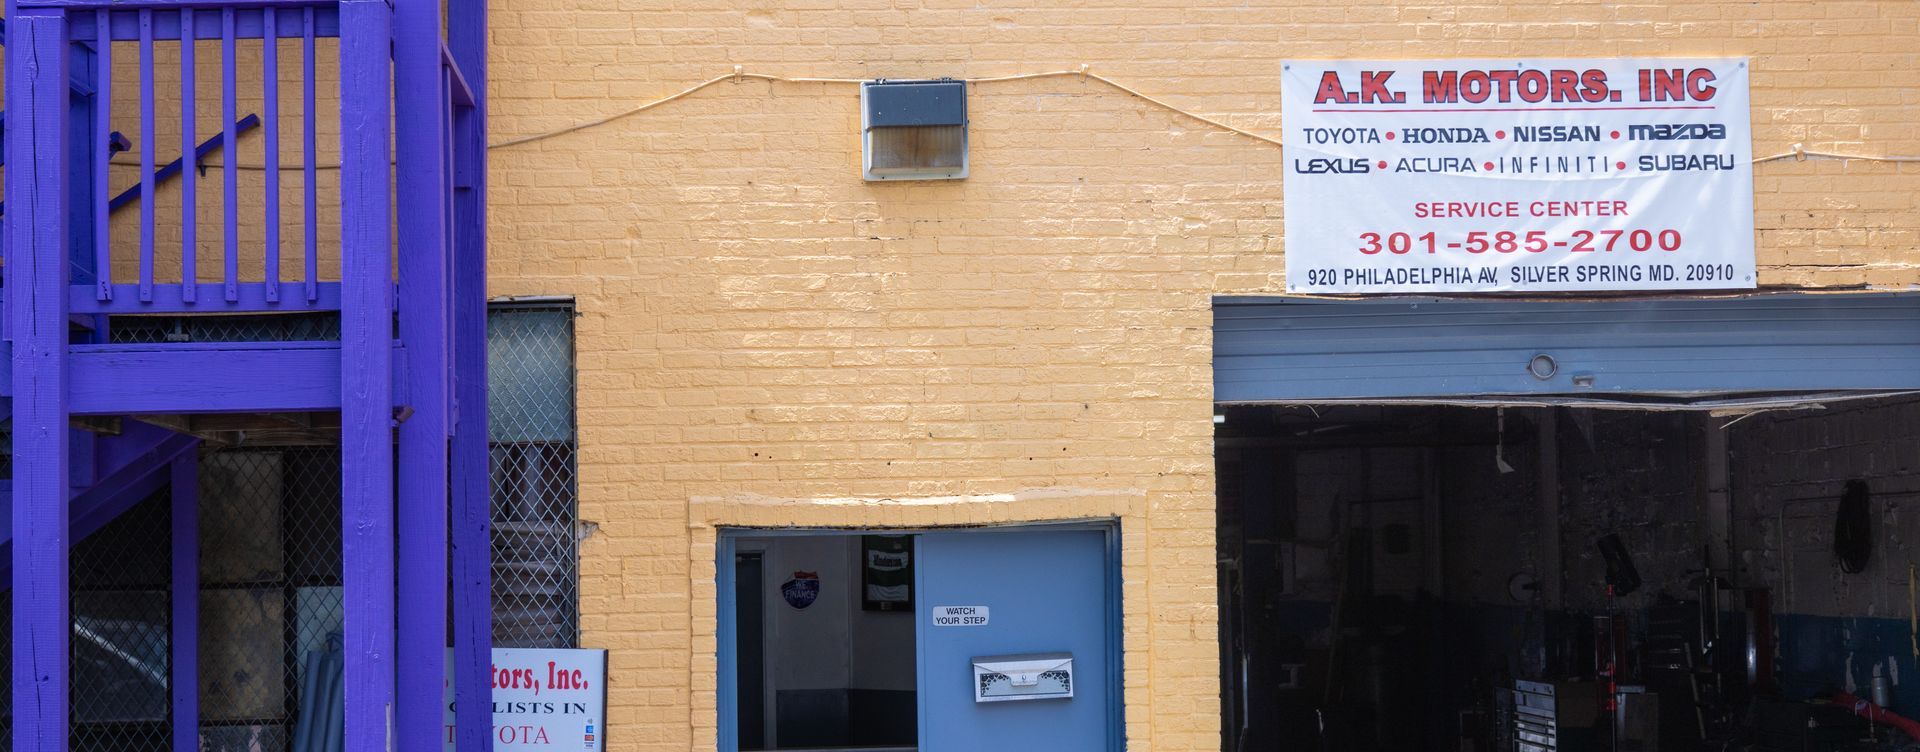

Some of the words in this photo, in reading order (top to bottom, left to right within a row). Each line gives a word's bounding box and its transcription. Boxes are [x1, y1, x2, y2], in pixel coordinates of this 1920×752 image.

[1313, 70, 1407, 104] A.K.
[1422, 68, 1623, 104] MOTORS.
[1638, 67, 1717, 102] INC
[1302, 127, 1381, 144] TOYOTA
[1401, 127, 1491, 144] HONDA
[1513, 125, 1601, 142] NISSAN
[1295, 158, 1370, 174] LEXUS
[1395, 157, 1477, 173] ACURA
[1499, 155, 1609, 174] INFINITI
[1638, 154, 1735, 171] SUBARU
[1414, 201, 1520, 218] SERVICE
[1529, 200, 1629, 217] CENTER
[1358, 229, 1682, 255] 301-585-2700
[1308, 268, 1337, 286] 920
[1344, 266, 1473, 285] PHILADELPHIA
[1477, 266, 1498, 286] AV,
[1510, 265, 1570, 283] SILVER
[1576, 264, 1642, 282] SPRING
[1649, 263, 1679, 281] MD.
[1686, 263, 1734, 281] 20910
[785, 590, 815, 600] FINANCE
[935, 616, 960, 625] YOUR
[963, 616, 986, 625] STEP
[945, 607, 976, 615] WATCH
[491, 663, 540, 696] tors,
[547, 661, 589, 690] Inc.
[563, 702, 587, 714] IN
[445, 725, 550, 744] TOTA
